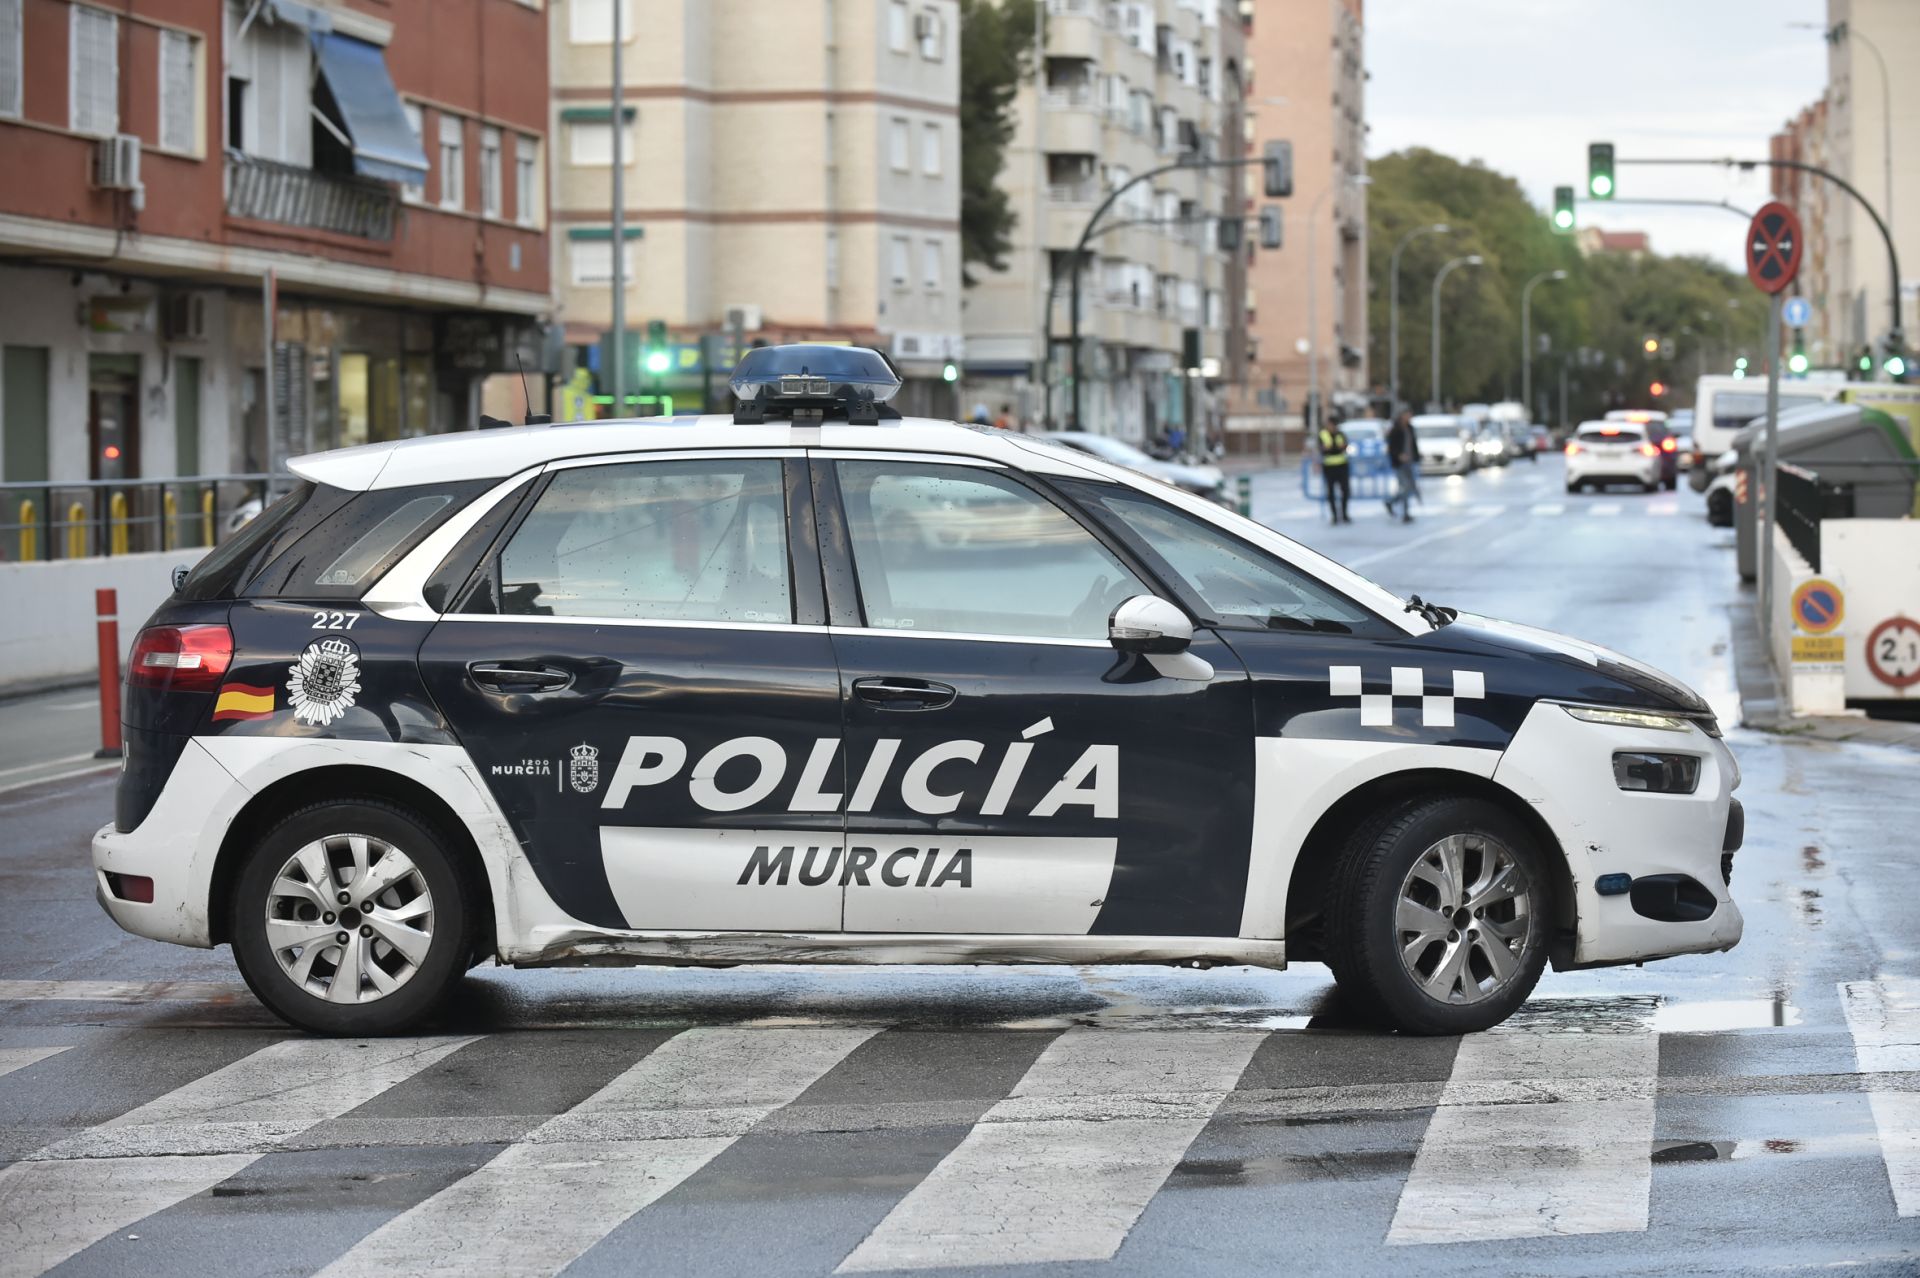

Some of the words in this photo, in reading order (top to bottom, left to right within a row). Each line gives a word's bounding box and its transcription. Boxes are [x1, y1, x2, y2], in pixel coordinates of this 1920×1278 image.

[312, 611, 361, 630] 227
[492, 765, 551, 775] MURCIA
[601, 716, 1119, 819] POLICÍA
[736, 846, 973, 889] MURCIA
